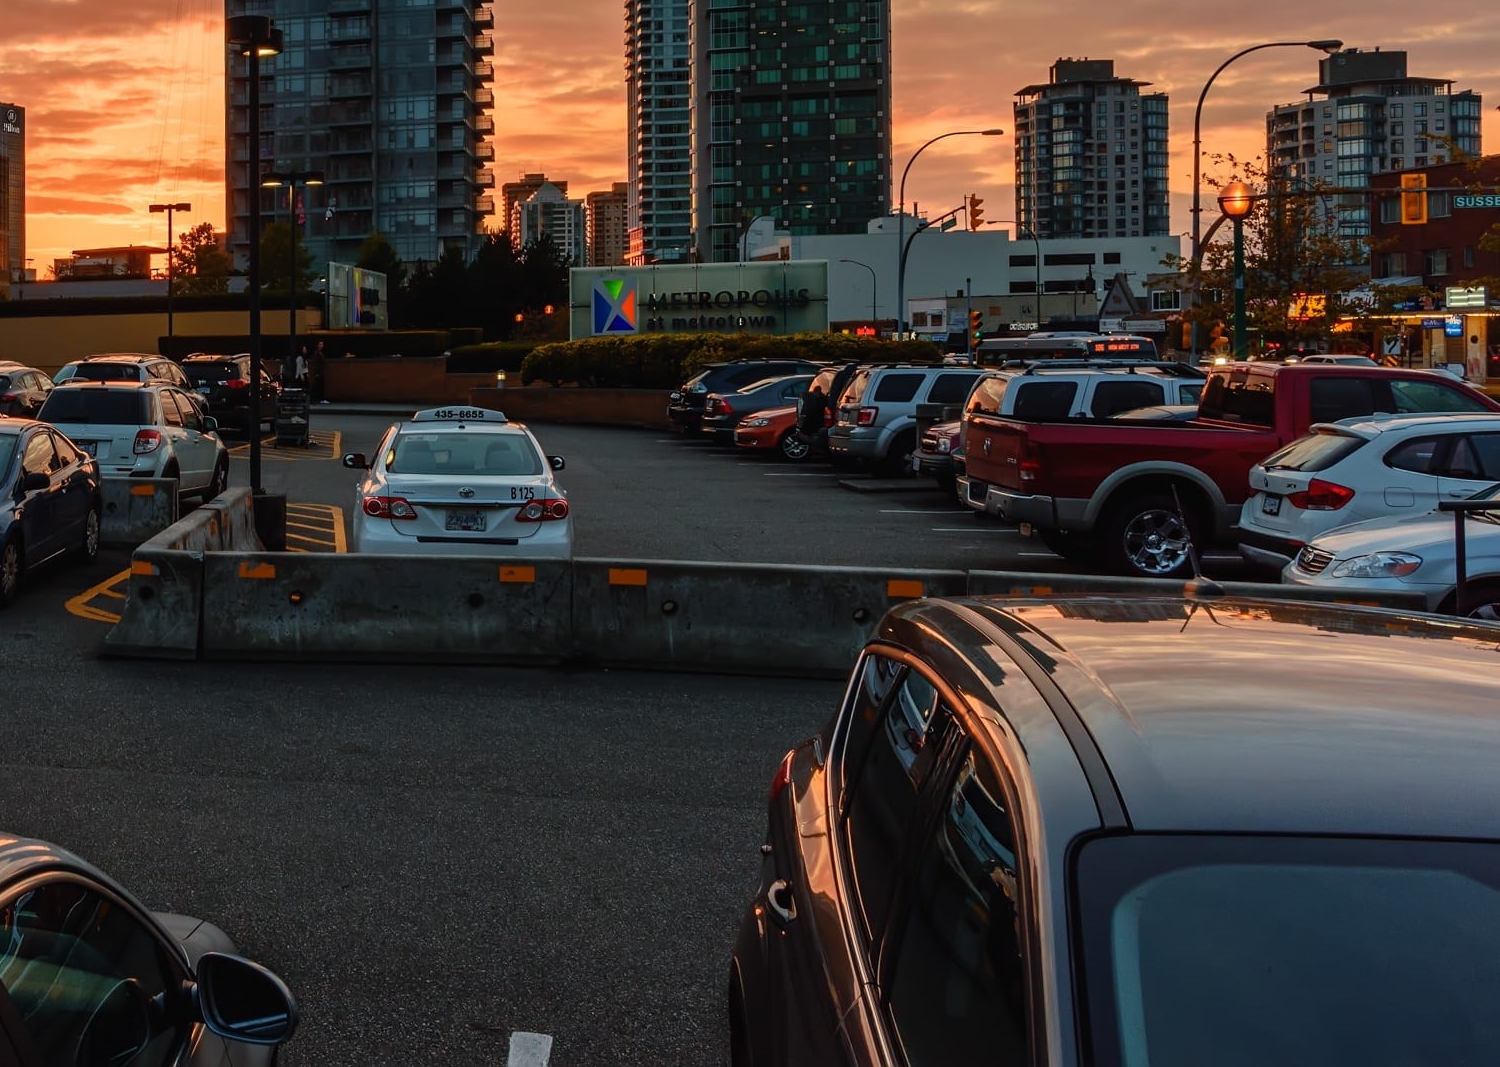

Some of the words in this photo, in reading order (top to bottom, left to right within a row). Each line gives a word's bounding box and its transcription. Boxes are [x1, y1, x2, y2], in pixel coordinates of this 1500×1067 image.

[647, 288, 811, 312] METROPOLIS
[647, 314, 664, 330] at
[671, 313, 777, 331] metrotown
[434, 410, 485, 419] 435-6655
[510, 486, 518, 500] B
[519, 487, 535, 500] 125
